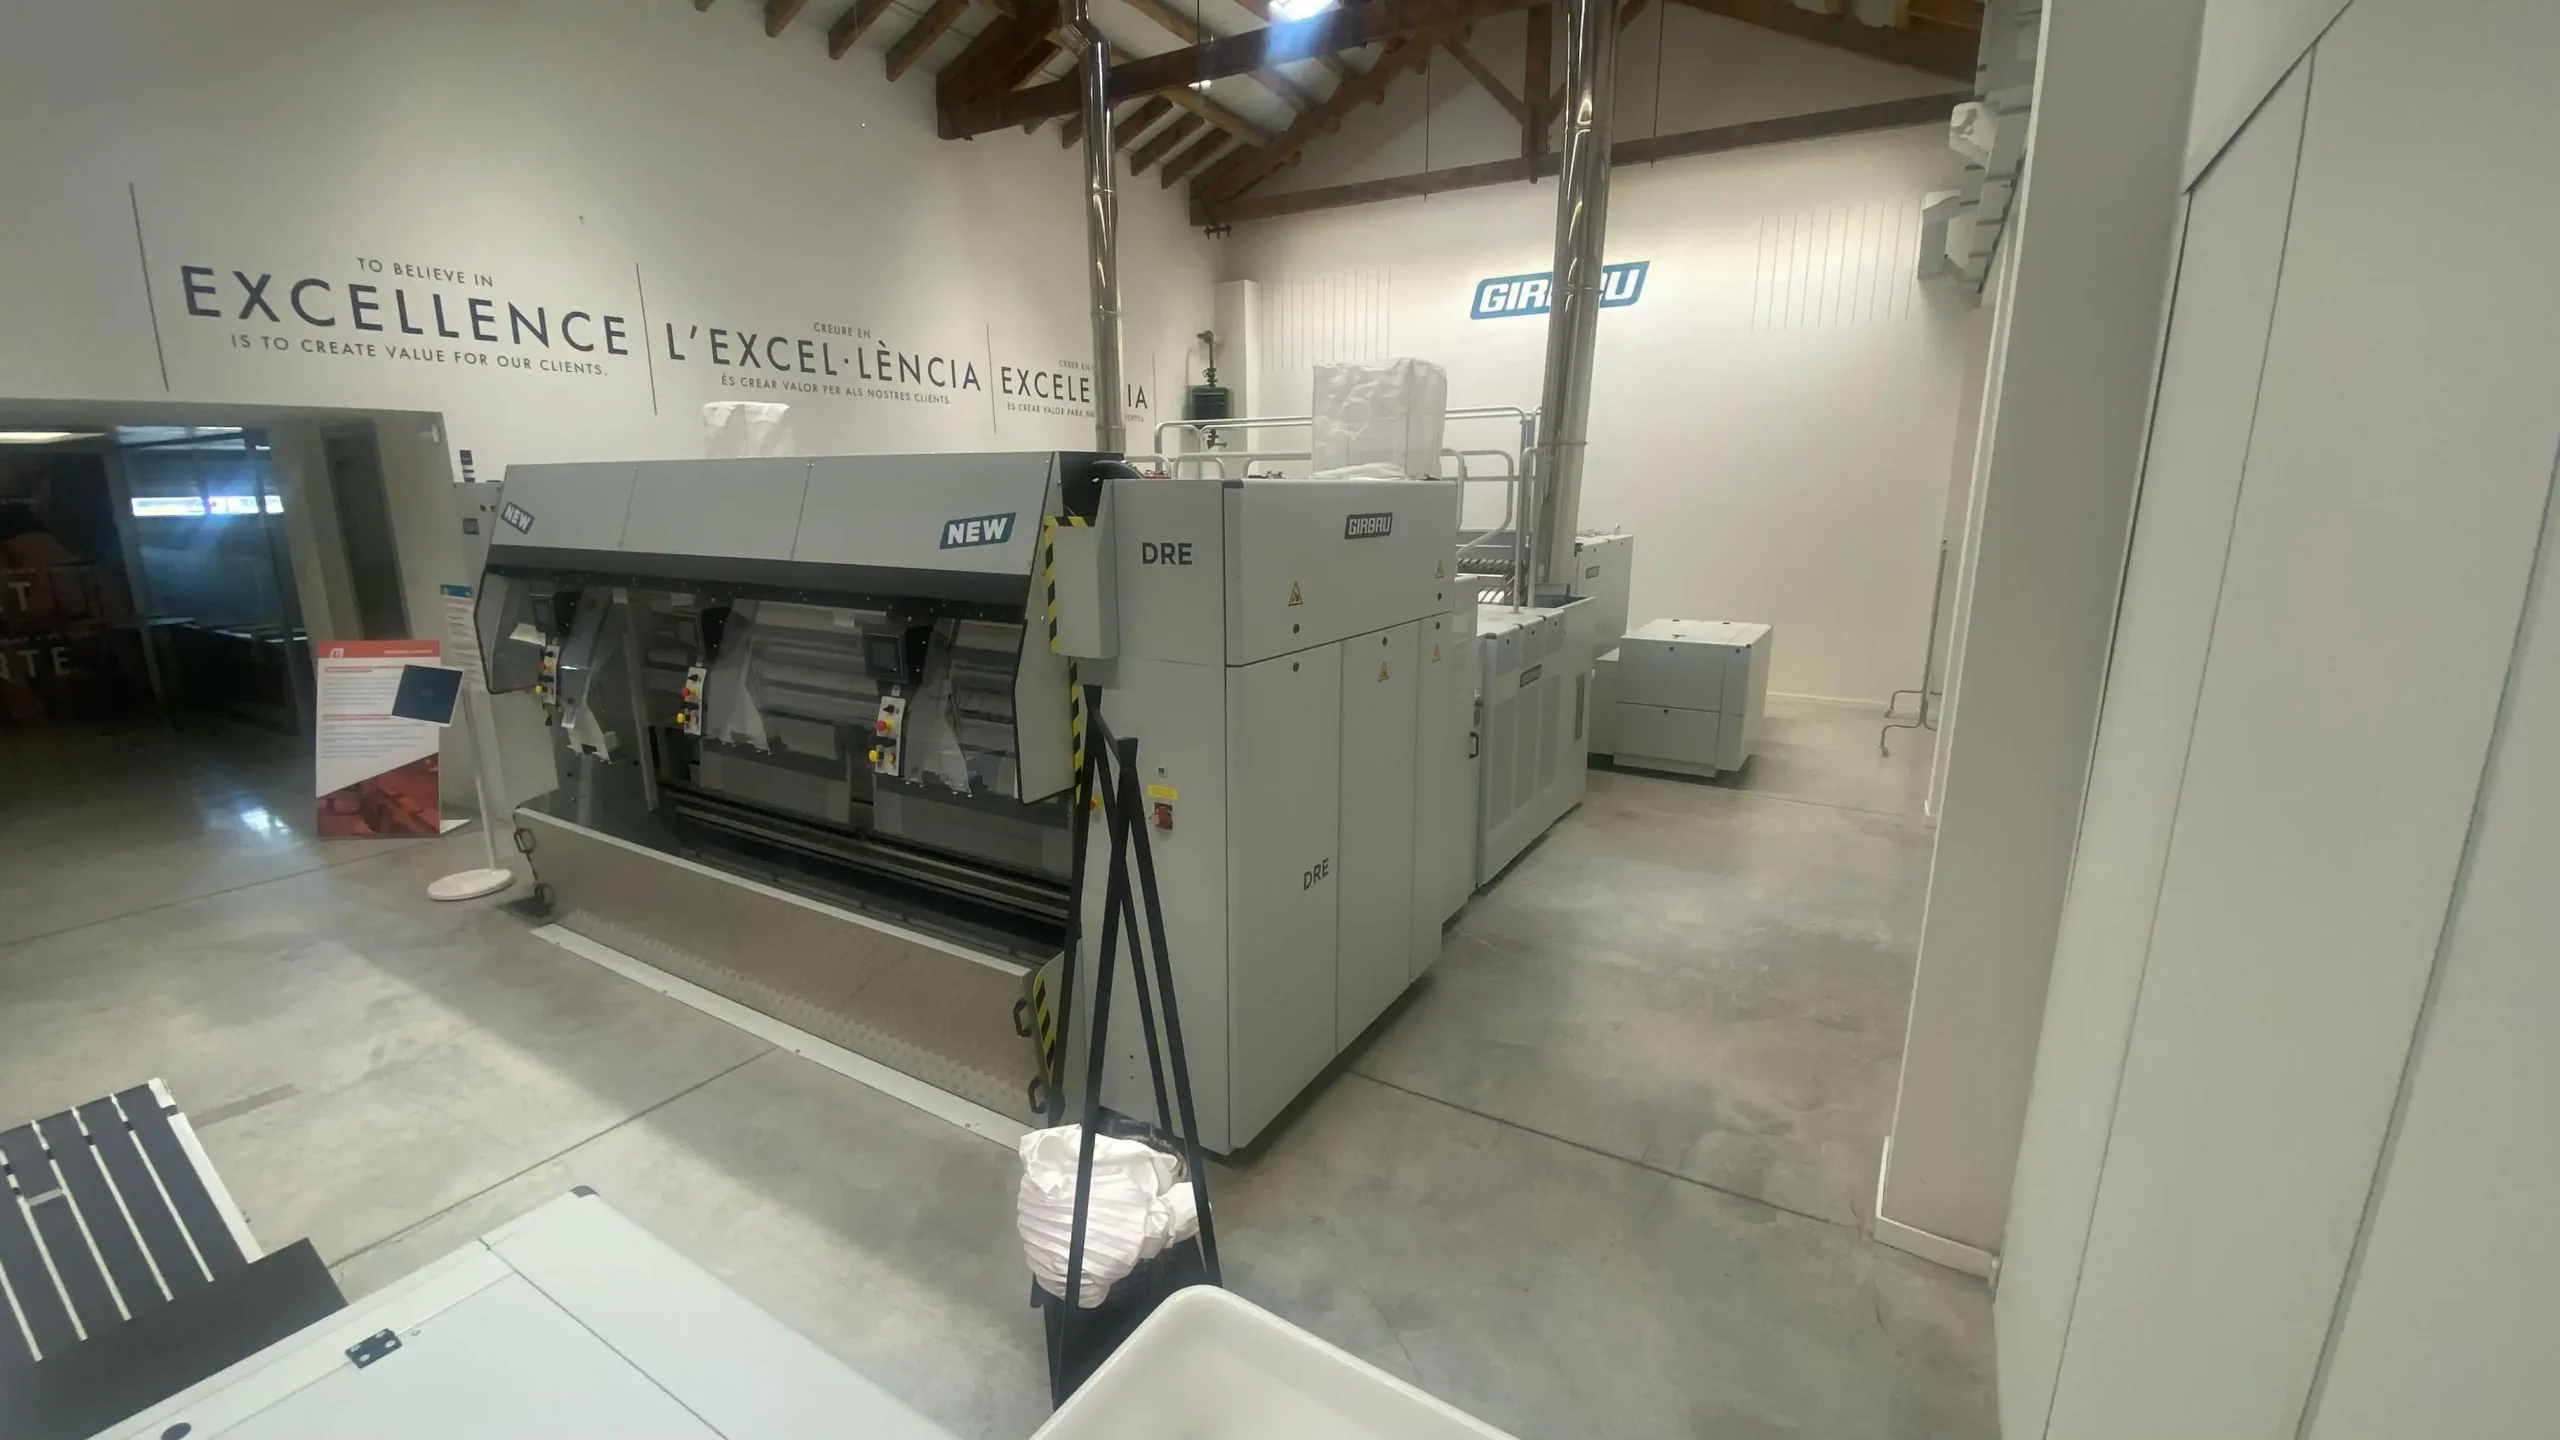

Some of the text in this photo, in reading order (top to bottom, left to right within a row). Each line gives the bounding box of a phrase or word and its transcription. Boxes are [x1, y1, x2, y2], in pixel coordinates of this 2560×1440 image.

[357, 257, 494, 288] TO BELIEVE IN
[1478, 268, 1641, 314] GIRU
[181, 264, 629, 356] EXCELLENCE
[813, 322, 871, 340] CREURE EN
[231, 334, 608, 376] IS TO CREATE VALUE FOR OUR CLIENTS.
[721, 373, 735, 387] ÉS
[740, 377, 778, 390] CREAR
[781, 380, 818, 396] VALOR
[823, 384, 841, 398] PER
[845, 387, 863, 397] ALS
[867, 389, 911, 402] NOSTRES
[1001, 366, 1148, 410] EXCELEIA
[504, 504, 531, 531] NEW
[947, 517, 1008, 546] NEW
[1348, 516, 1391, 536] GIRBAU
[1141, 542, 1194, 567] DRE
[1303, 857, 1330, 891] DRE
